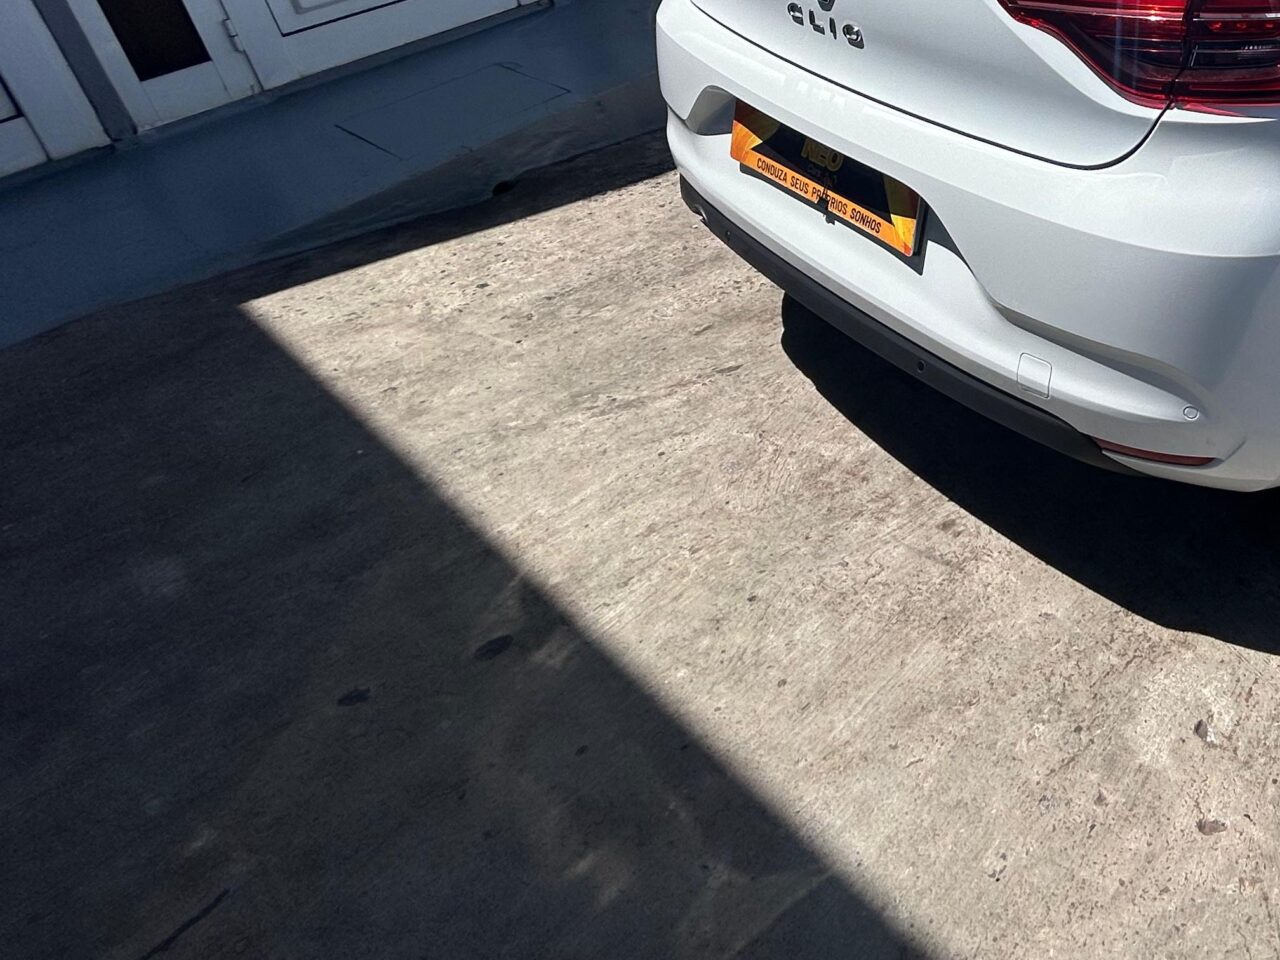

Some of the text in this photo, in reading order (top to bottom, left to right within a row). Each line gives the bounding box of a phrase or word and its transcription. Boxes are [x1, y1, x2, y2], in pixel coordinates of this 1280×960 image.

[787, 2, 865, 50] CLIO
[801, 138, 845, 172] NEO
[756, 157, 882, 234] CONDUZA SEUS PRRIOS SONHOS
